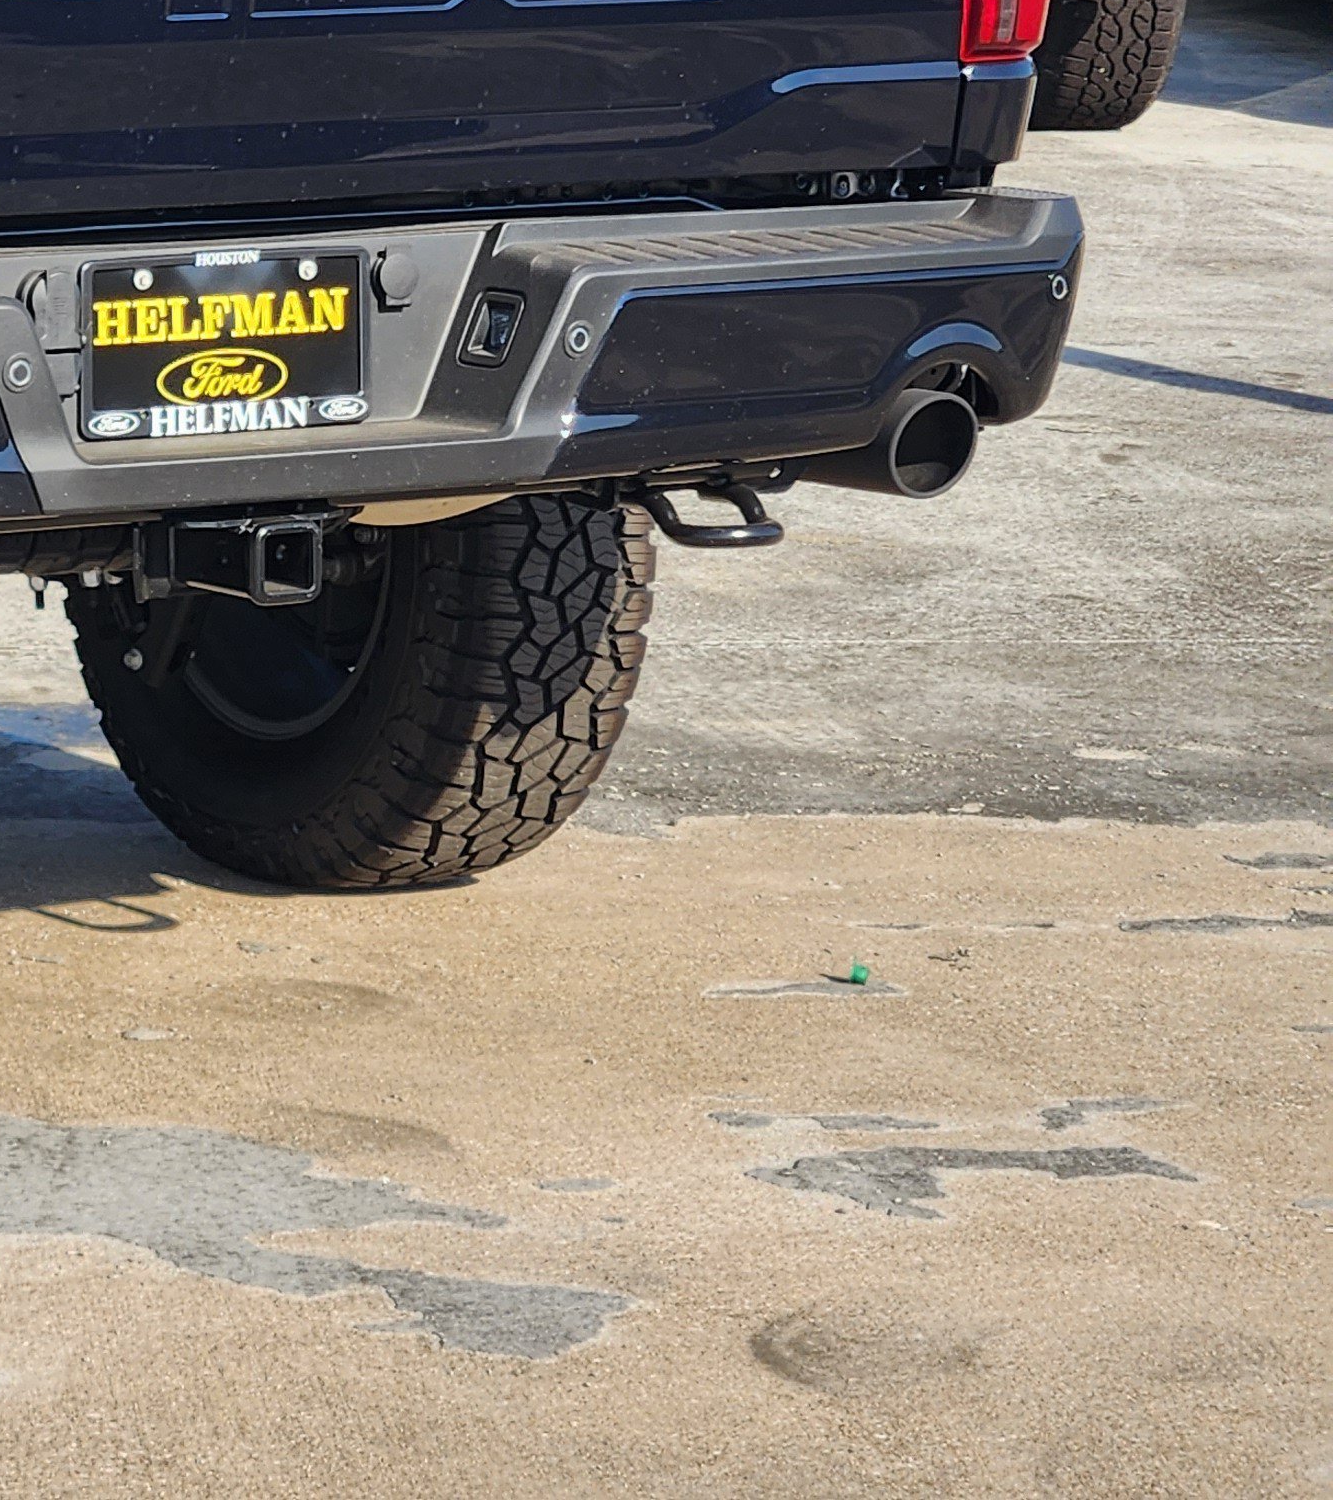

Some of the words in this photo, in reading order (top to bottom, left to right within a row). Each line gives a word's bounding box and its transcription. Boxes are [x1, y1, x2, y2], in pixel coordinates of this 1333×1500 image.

[194, 248, 262, 268] HOUSTON
[92, 286, 350, 347] HELFMAN
[182, 355, 266, 399] Ford
[149, 396, 312, 438] HELFMAN
